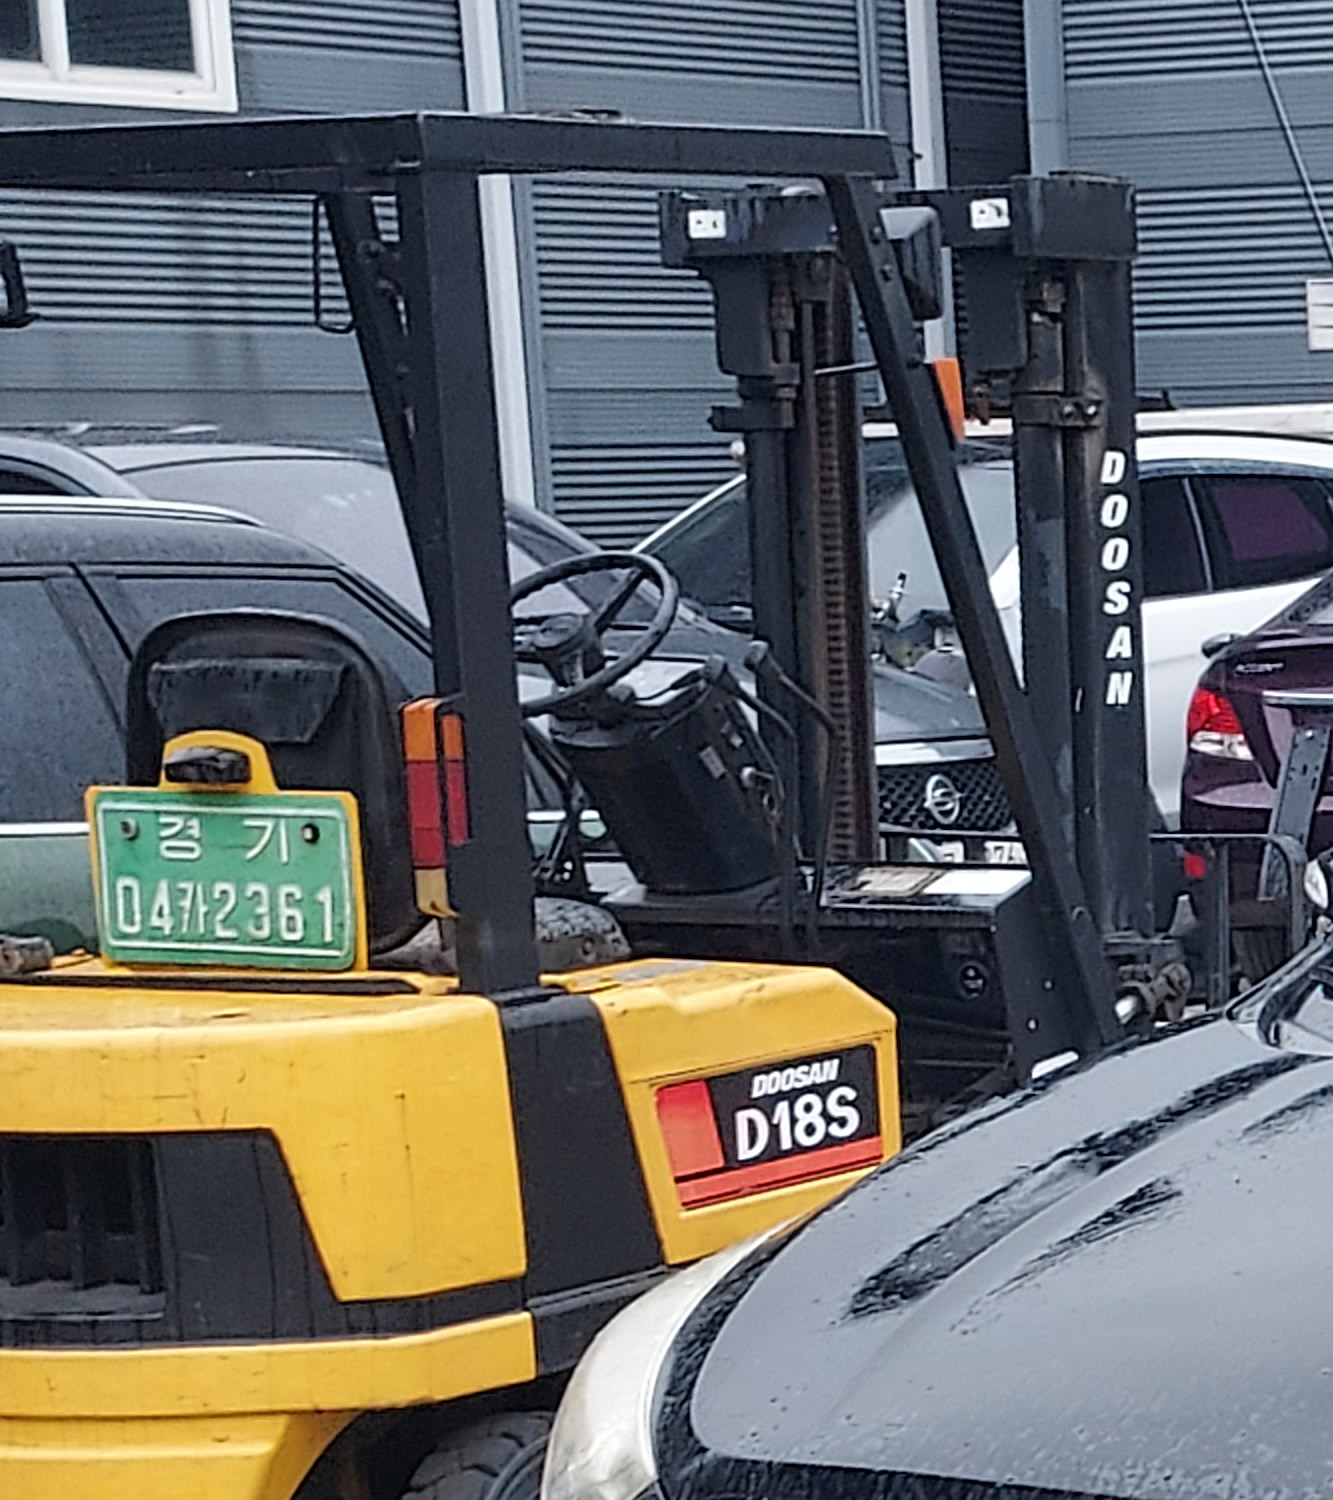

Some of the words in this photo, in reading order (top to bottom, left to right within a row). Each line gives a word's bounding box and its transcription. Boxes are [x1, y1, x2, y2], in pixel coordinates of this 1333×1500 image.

[1100, 450, 1133, 705] DOOSAN
[158, 814, 290, 864] 경기
[115, 875, 335, 944] 04카2361
[750, 1058, 841, 1099] DOOSAN
[734, 1085, 861, 1162] D18S
